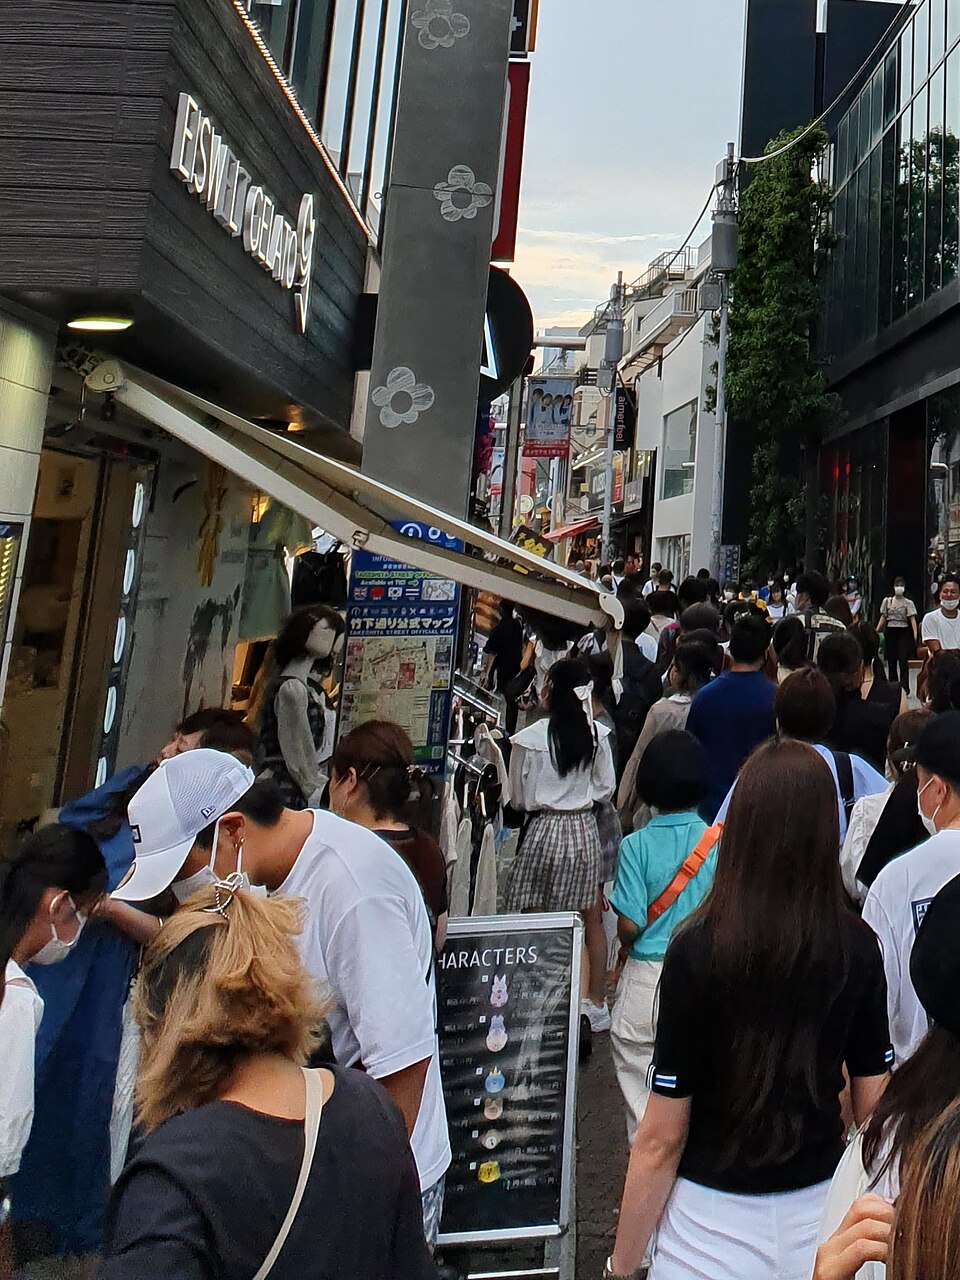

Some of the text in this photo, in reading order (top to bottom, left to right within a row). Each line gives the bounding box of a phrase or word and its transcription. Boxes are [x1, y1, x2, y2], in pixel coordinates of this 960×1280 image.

[170, 91, 298, 290] EISWELT GELATO
[350, 616, 454, 630] 竹下通り公式マップ
[437, 945, 538, 970] HARACTERS
